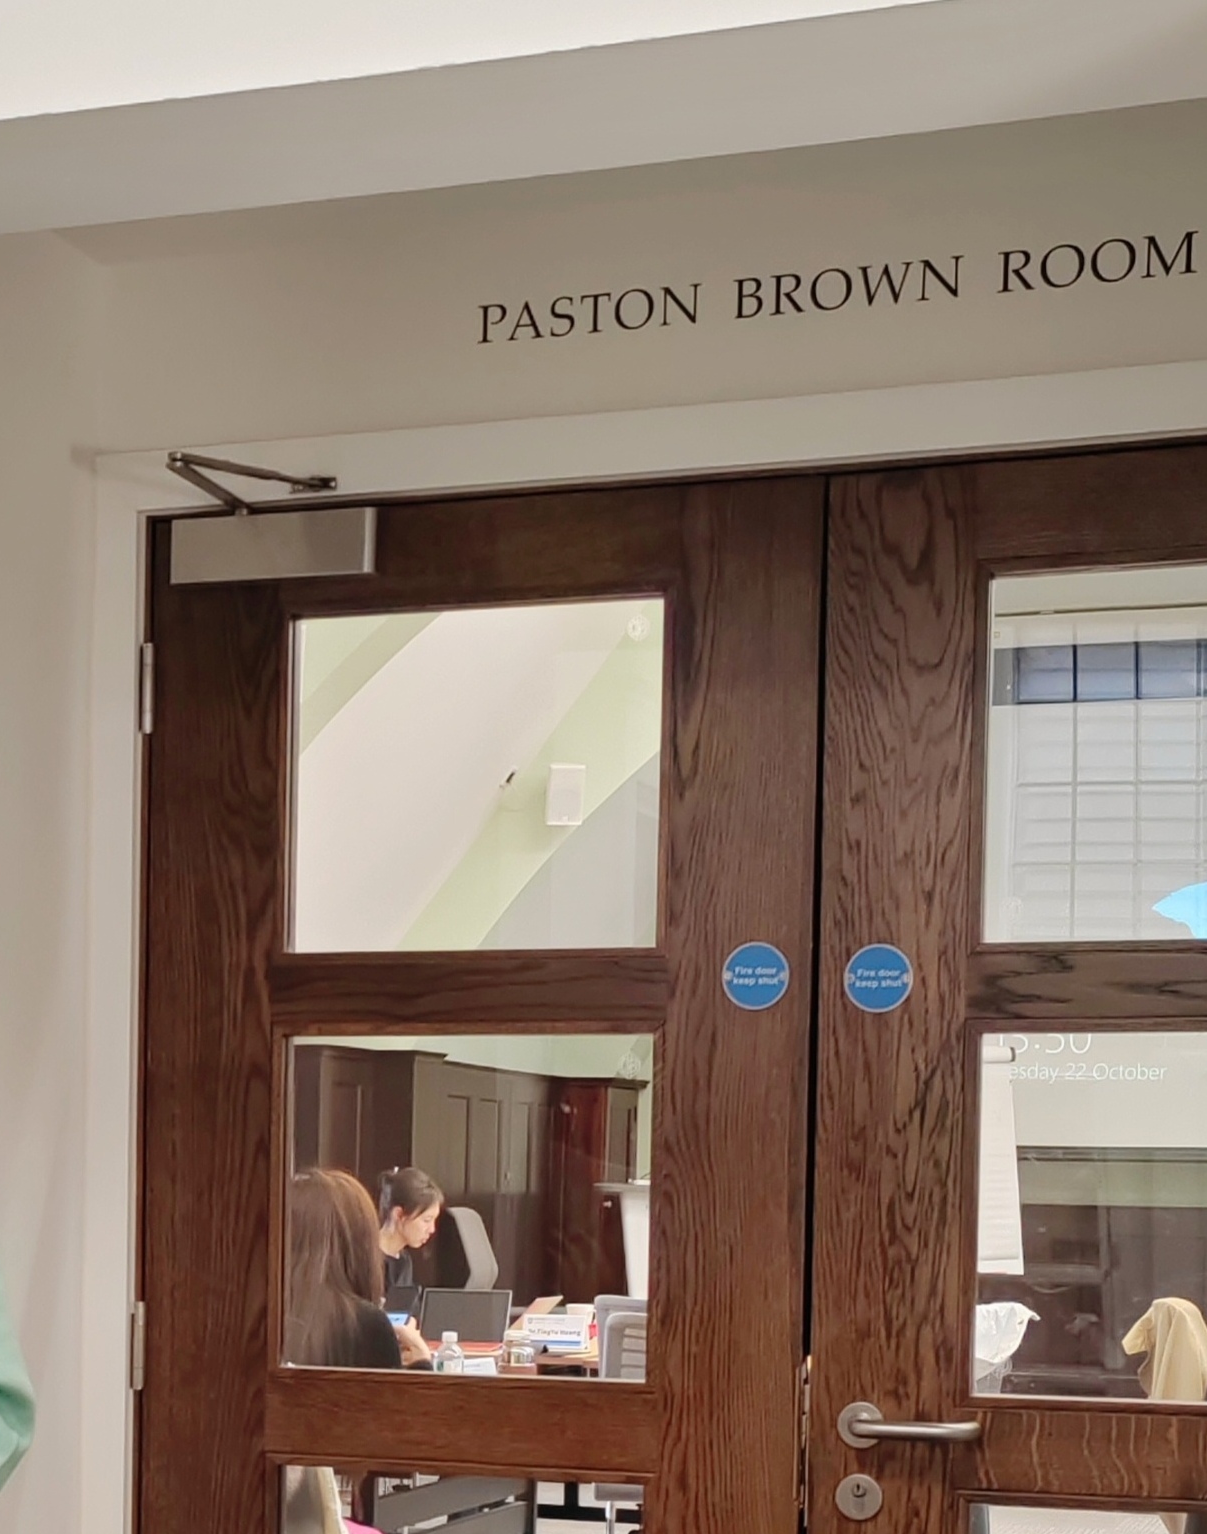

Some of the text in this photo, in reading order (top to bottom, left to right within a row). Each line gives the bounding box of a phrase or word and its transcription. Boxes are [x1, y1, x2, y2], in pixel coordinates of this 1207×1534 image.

[477, 231, 1199, 344] PASTON BROWN ROOM
[1009, 1061, 1168, 1084] esday 22 October
